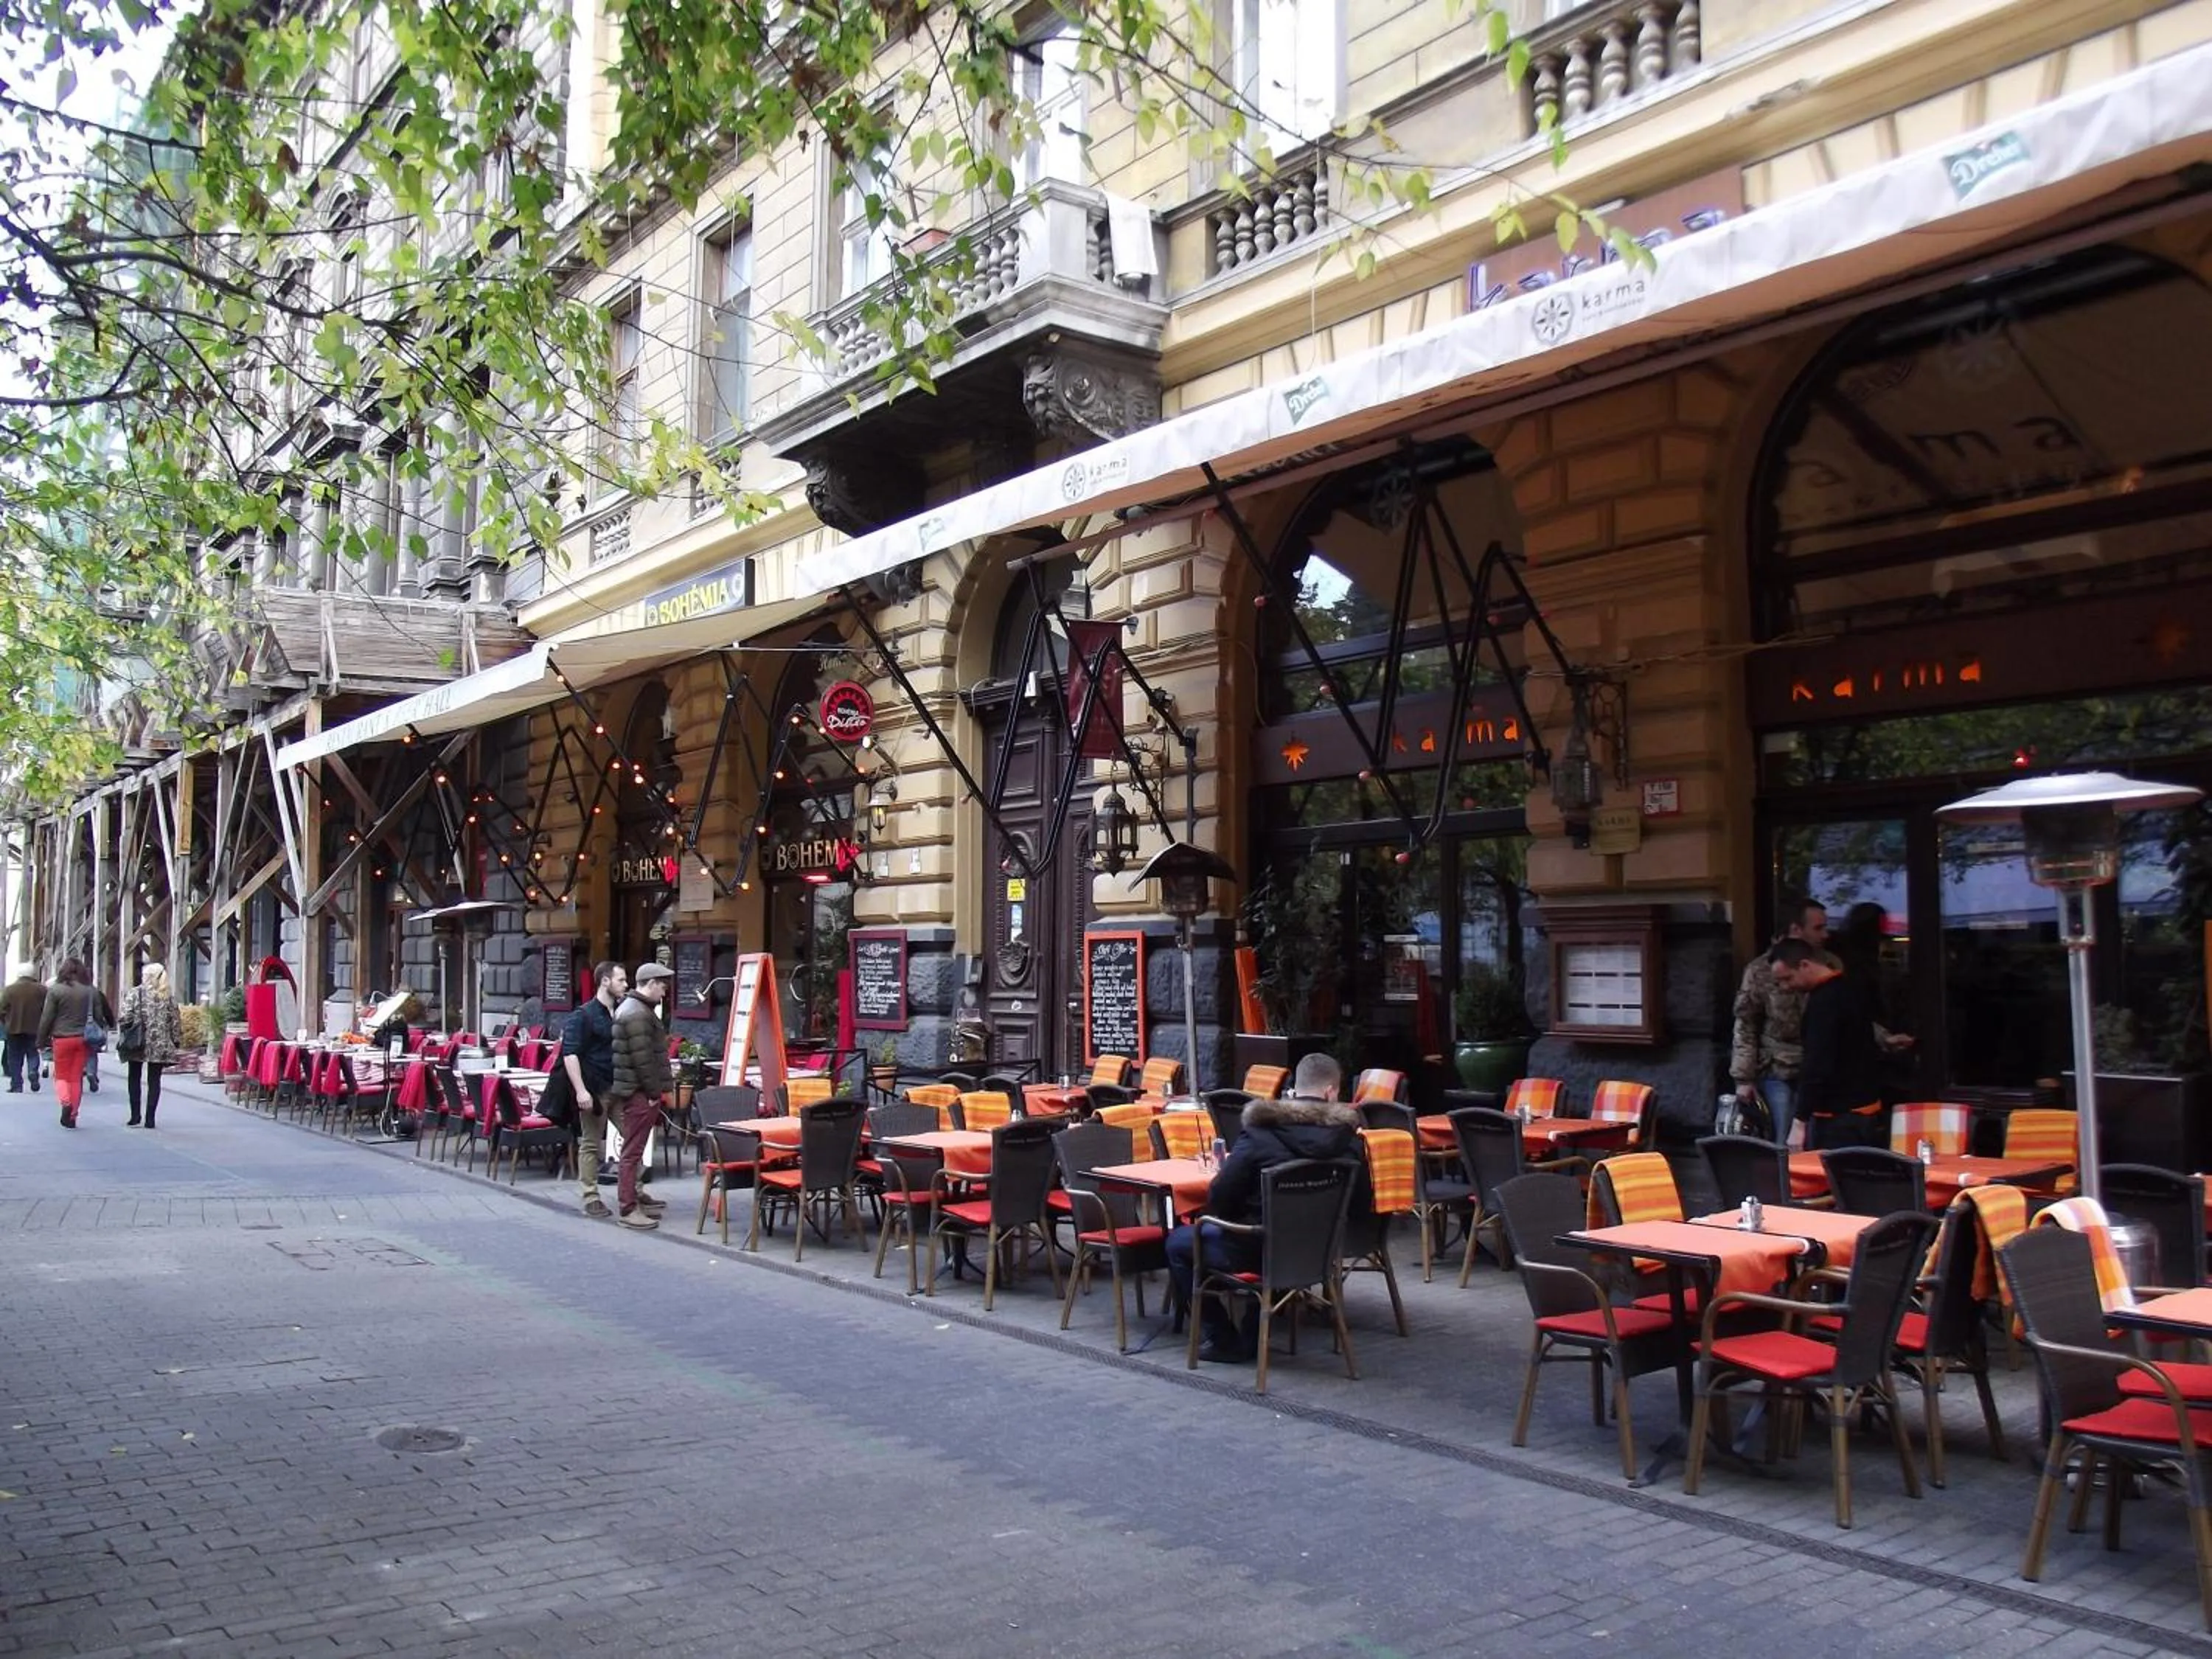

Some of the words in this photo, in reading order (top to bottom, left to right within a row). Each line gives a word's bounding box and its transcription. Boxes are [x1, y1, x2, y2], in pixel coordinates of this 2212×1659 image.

[1582, 279, 1645, 309] karma
[658, 577, 730, 625] BOHÉMIA
[1392, 717, 1519, 754] kama
